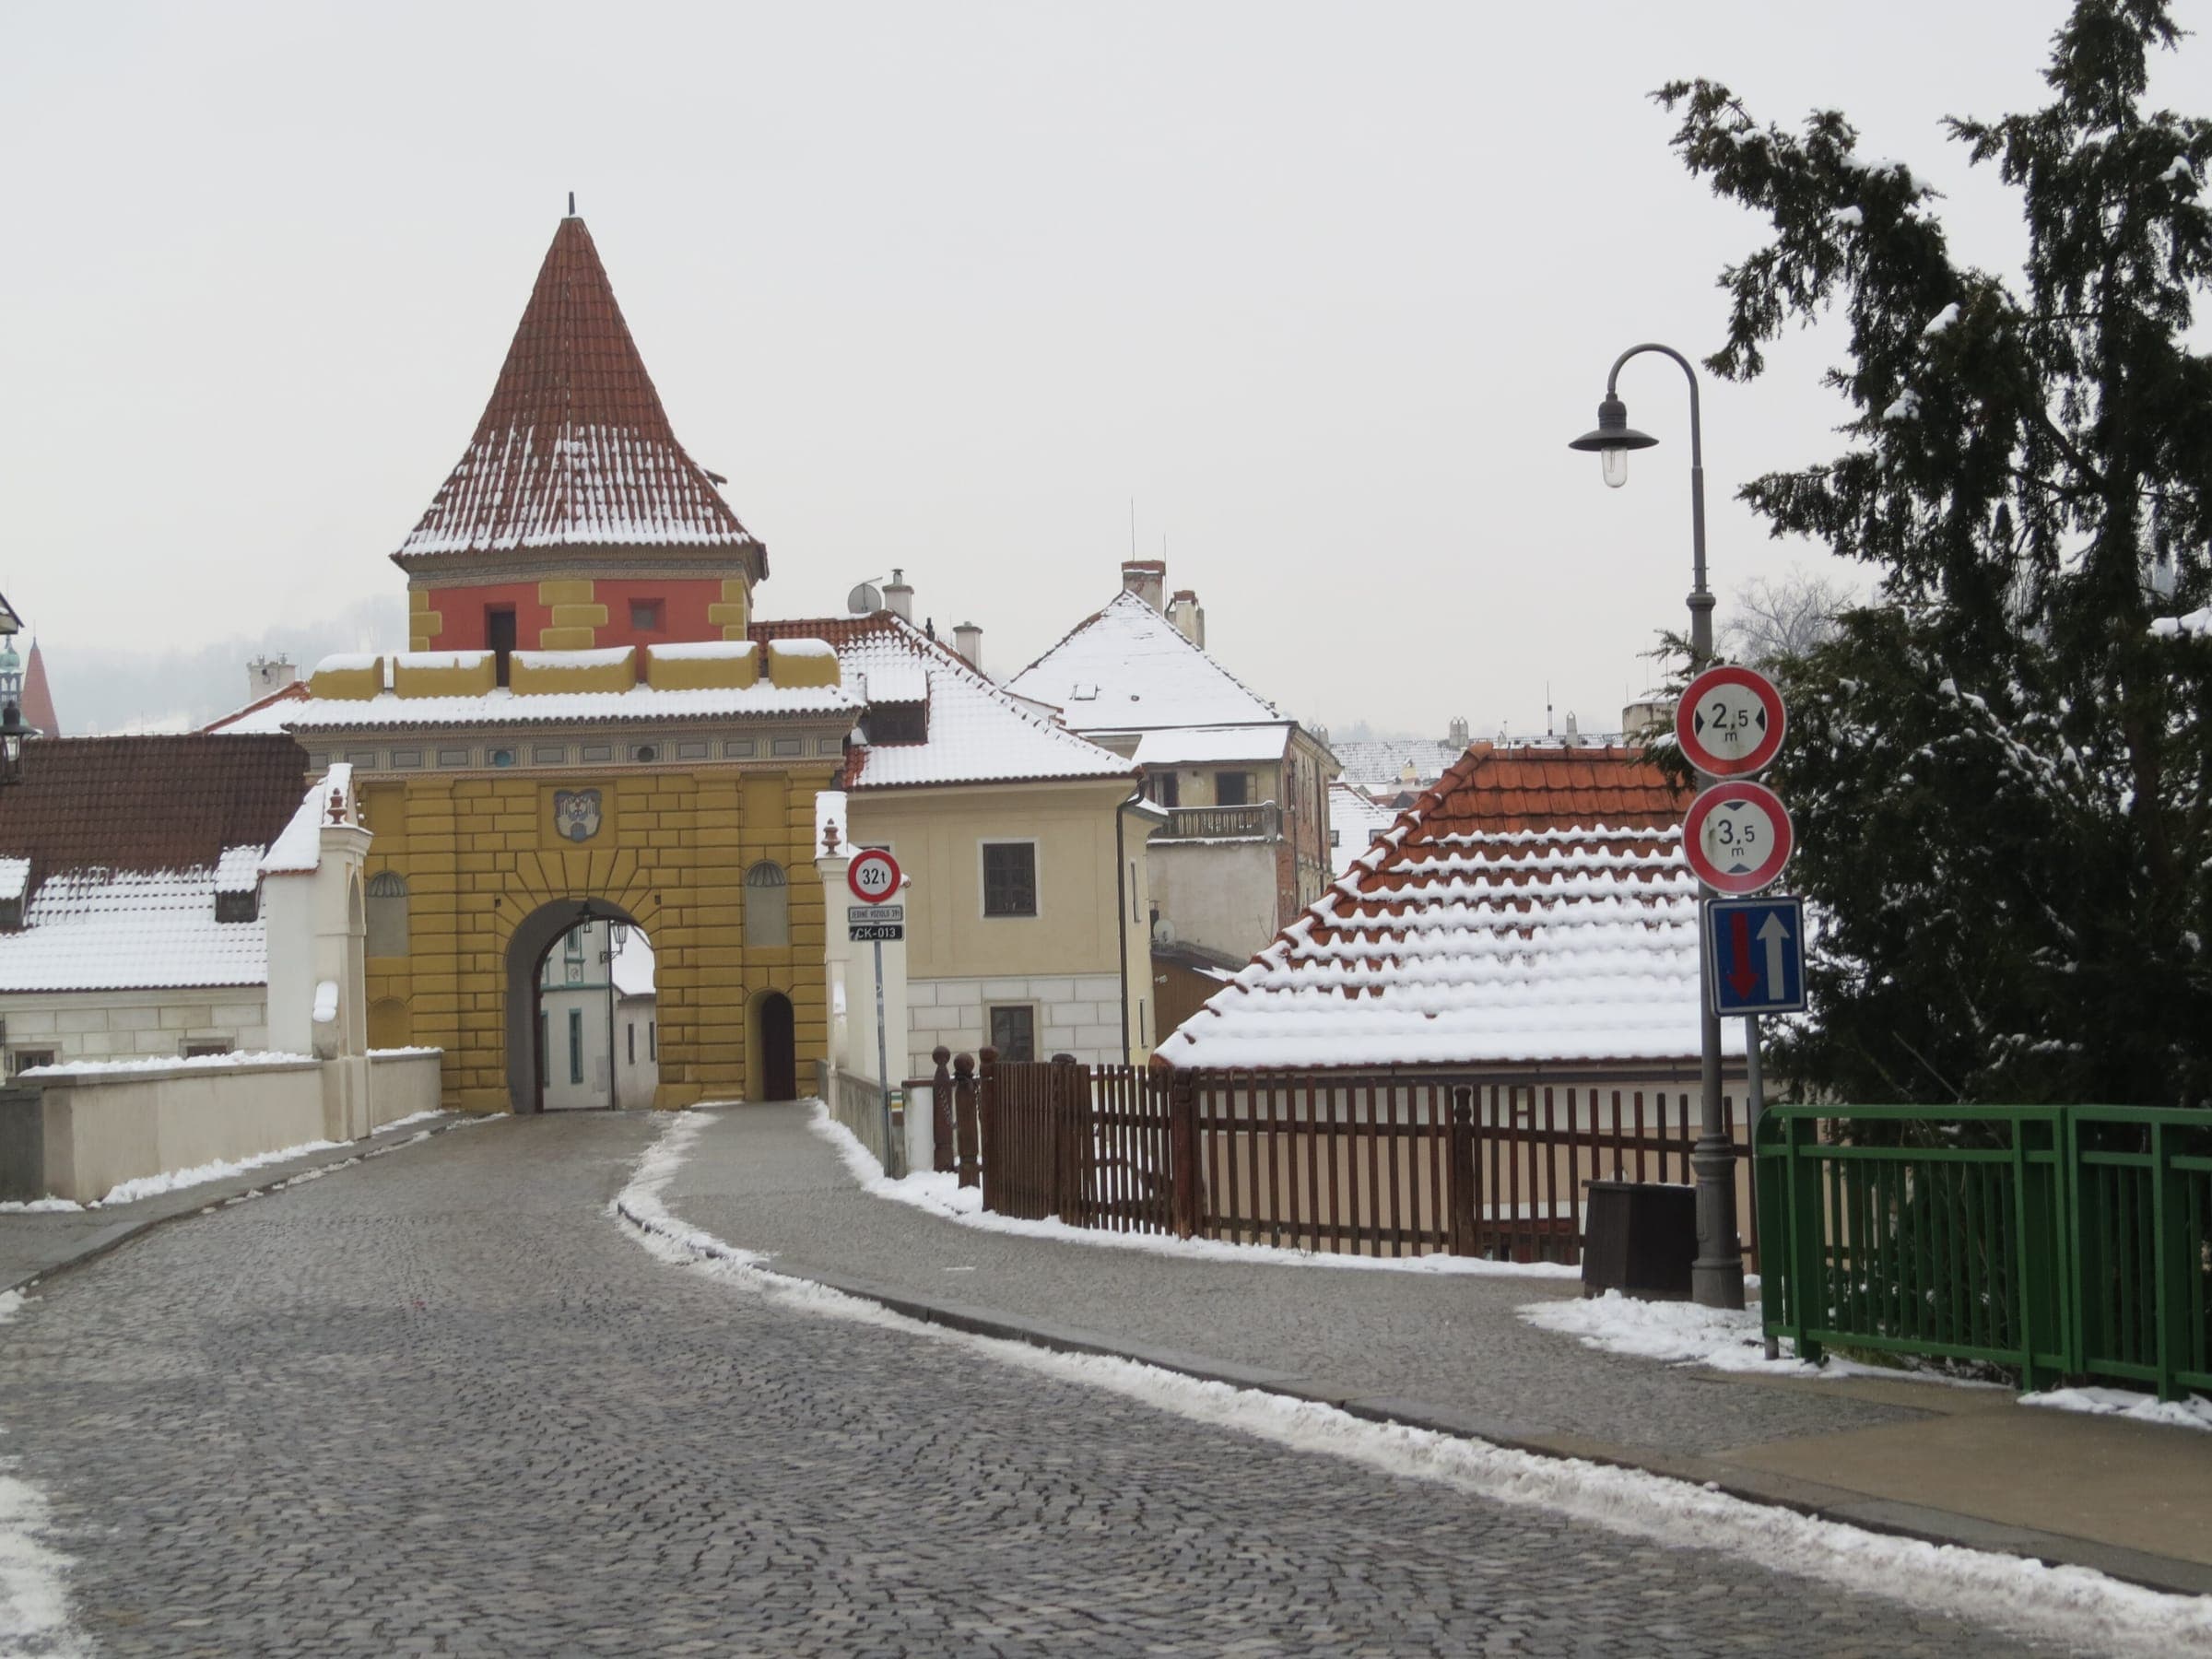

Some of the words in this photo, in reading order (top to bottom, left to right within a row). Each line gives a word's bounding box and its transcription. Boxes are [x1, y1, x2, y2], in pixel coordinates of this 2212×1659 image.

[1712, 702, 1748, 730] 2,5
[1724, 732, 1737, 742] m
[1718, 818, 1755, 845] 3,5
[1731, 847, 1745, 857] m
[856, 927, 896, 938] CK-013
